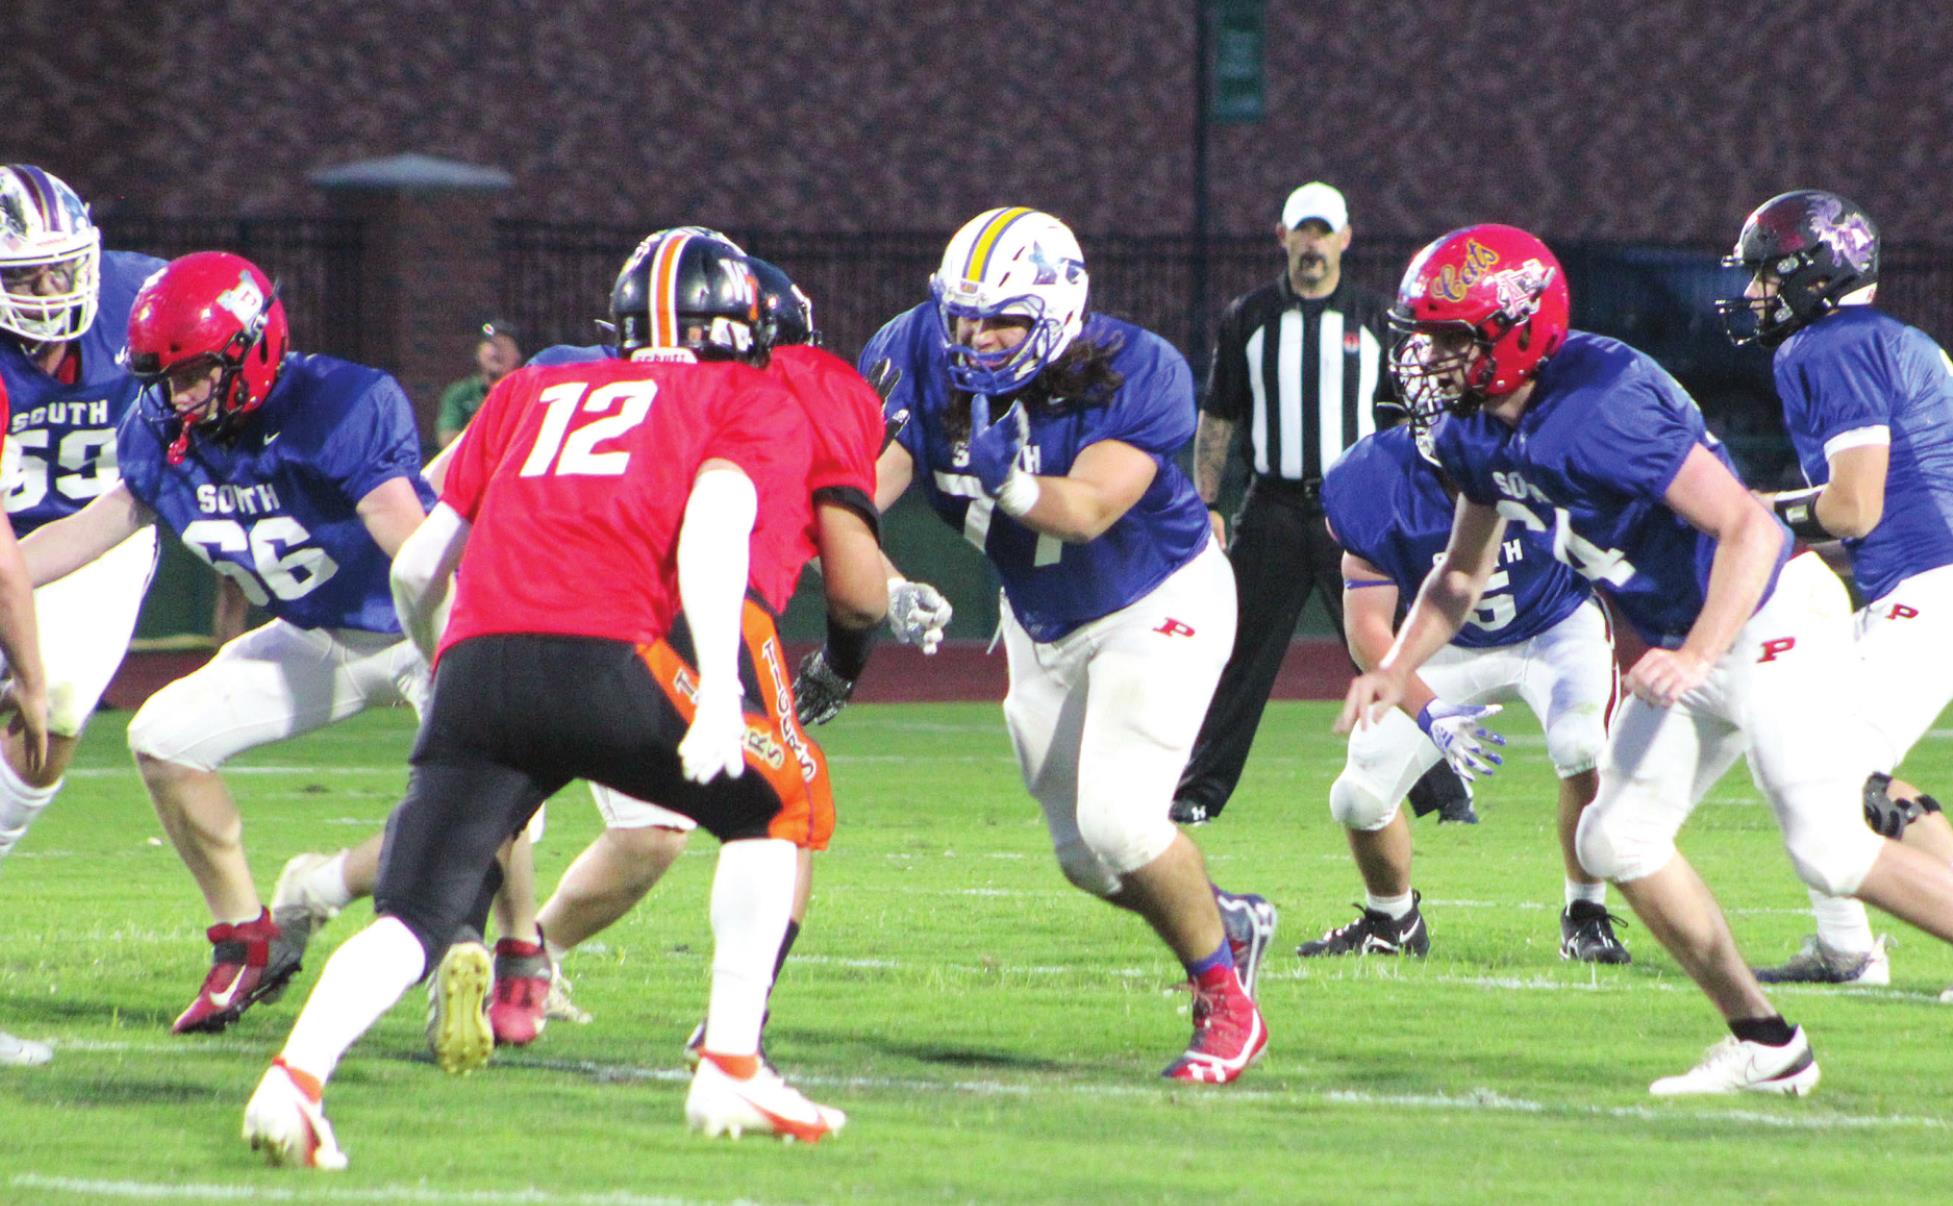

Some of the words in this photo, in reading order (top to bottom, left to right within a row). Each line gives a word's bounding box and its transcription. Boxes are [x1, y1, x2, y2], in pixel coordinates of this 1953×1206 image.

[12, 399, 108, 433] SOUTH
[519, 379, 659, 477] 12
[2, 426, 118, 512] 59
[933, 469, 1062, 568] 7
[182, 516, 339, 607] 66
[1152, 617, 1195, 637] P
[1890, 603, 1919, 620] P
[1756, 636, 1796, 663] P
